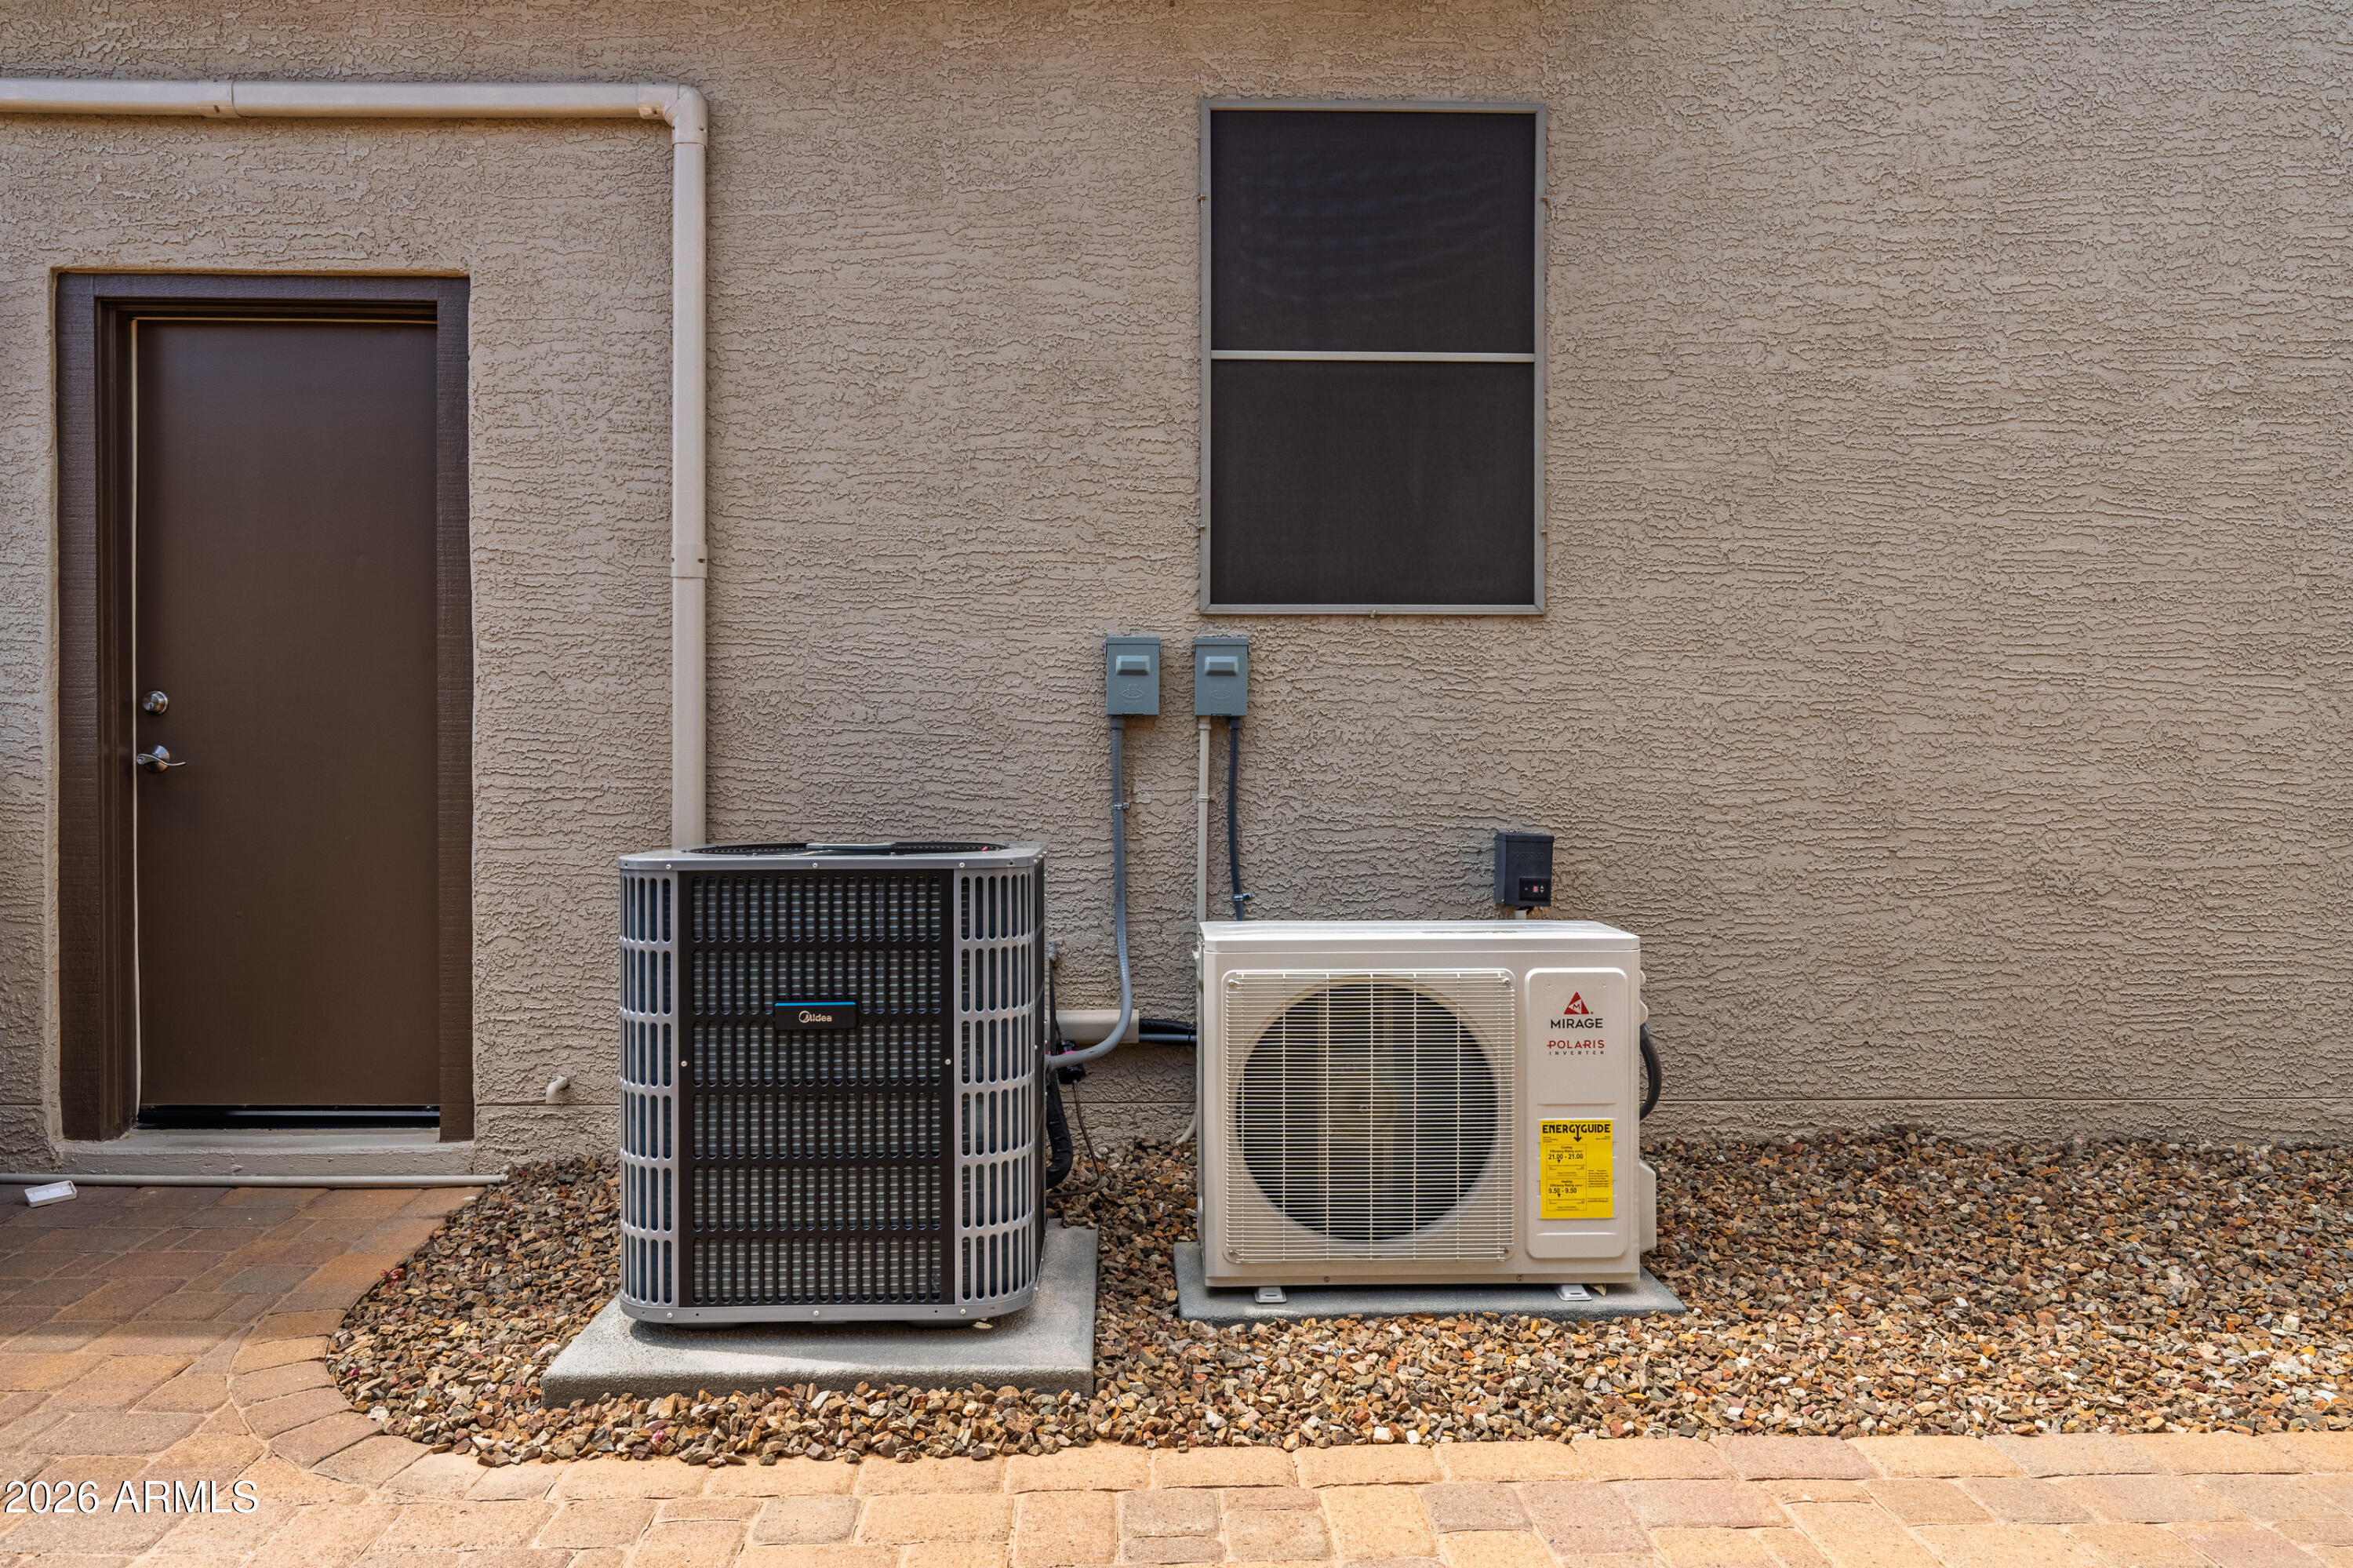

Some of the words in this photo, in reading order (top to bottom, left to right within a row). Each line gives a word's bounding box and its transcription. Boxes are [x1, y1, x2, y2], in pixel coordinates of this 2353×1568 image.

[798, 1010, 832, 1023] Midea
[1551, 1018, 1603, 1028] MIRAGE
[1547, 1039, 1605, 1049] POLARIS
[1542, 1124, 1611, 1134] ENERGYGUIDE
